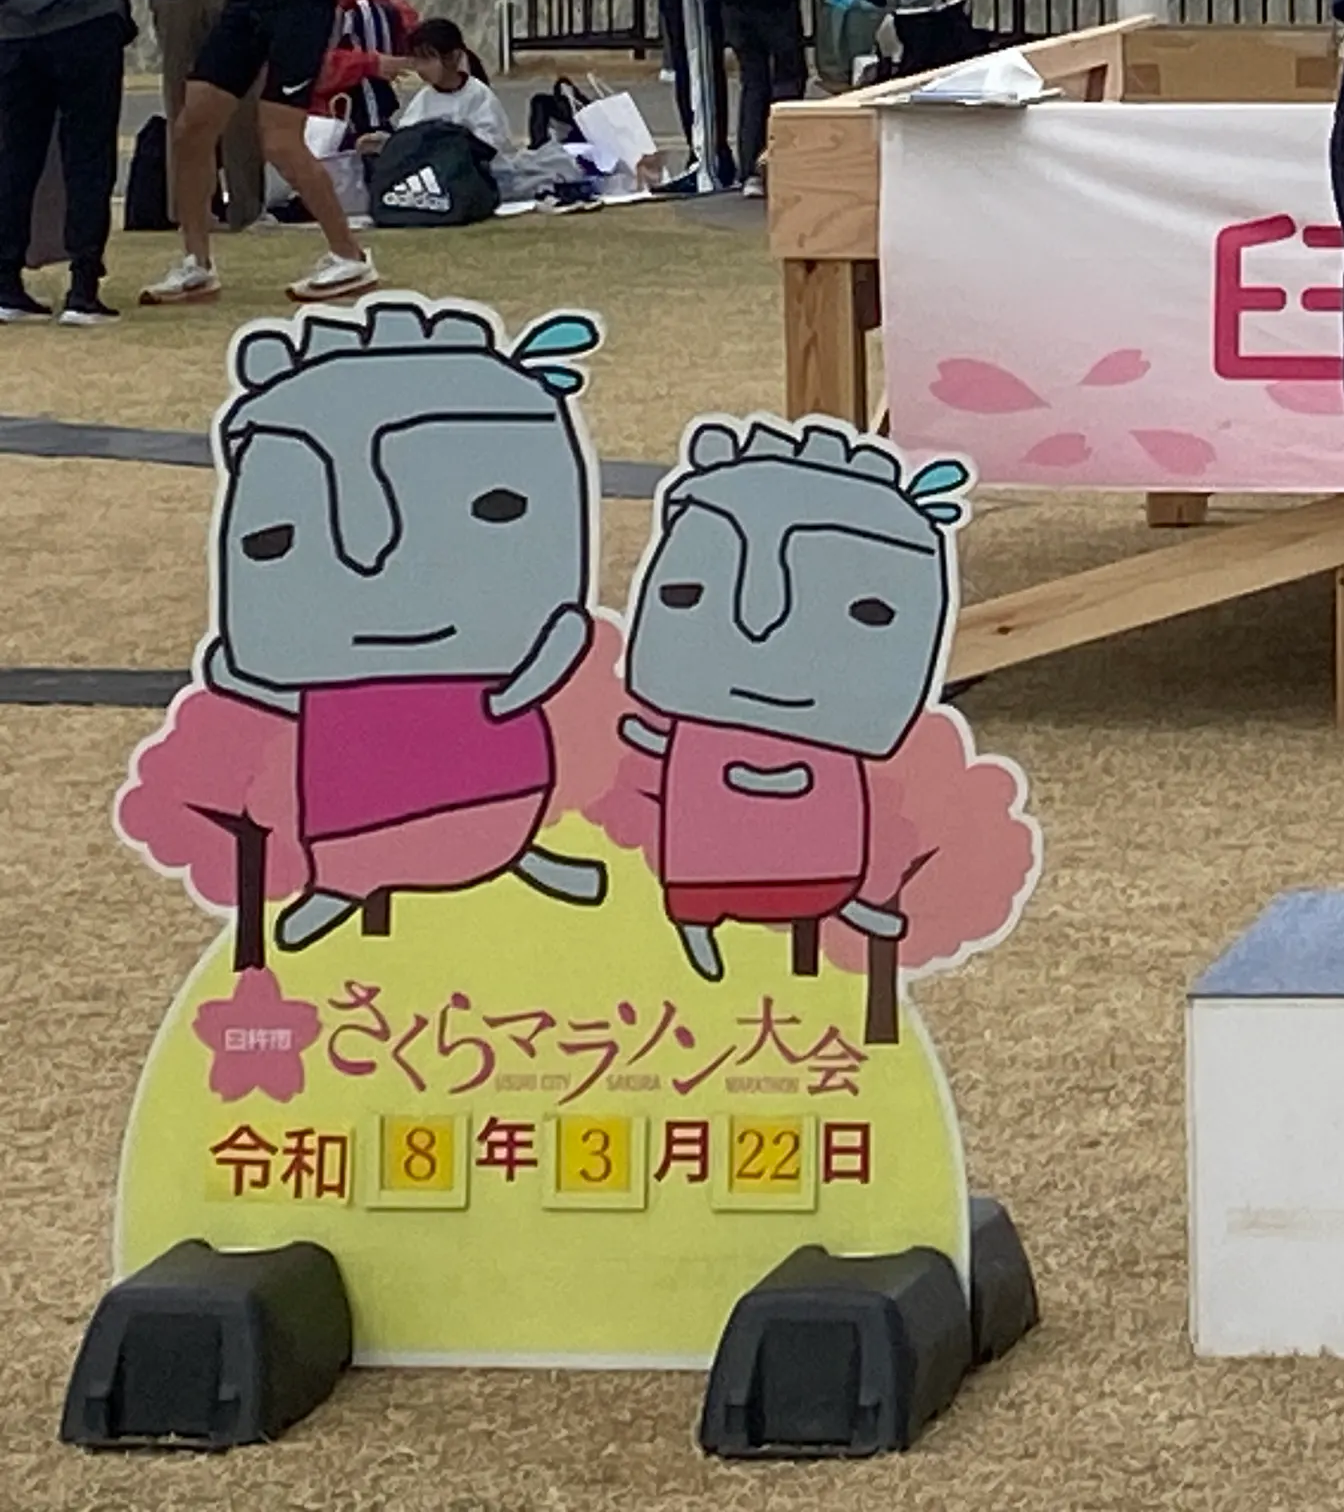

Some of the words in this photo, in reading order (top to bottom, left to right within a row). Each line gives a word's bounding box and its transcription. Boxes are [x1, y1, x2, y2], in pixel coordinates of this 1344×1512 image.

[225, 1028, 292, 1051] 臼杵市
[327, 980, 869, 1106] さくらマラソン大会
